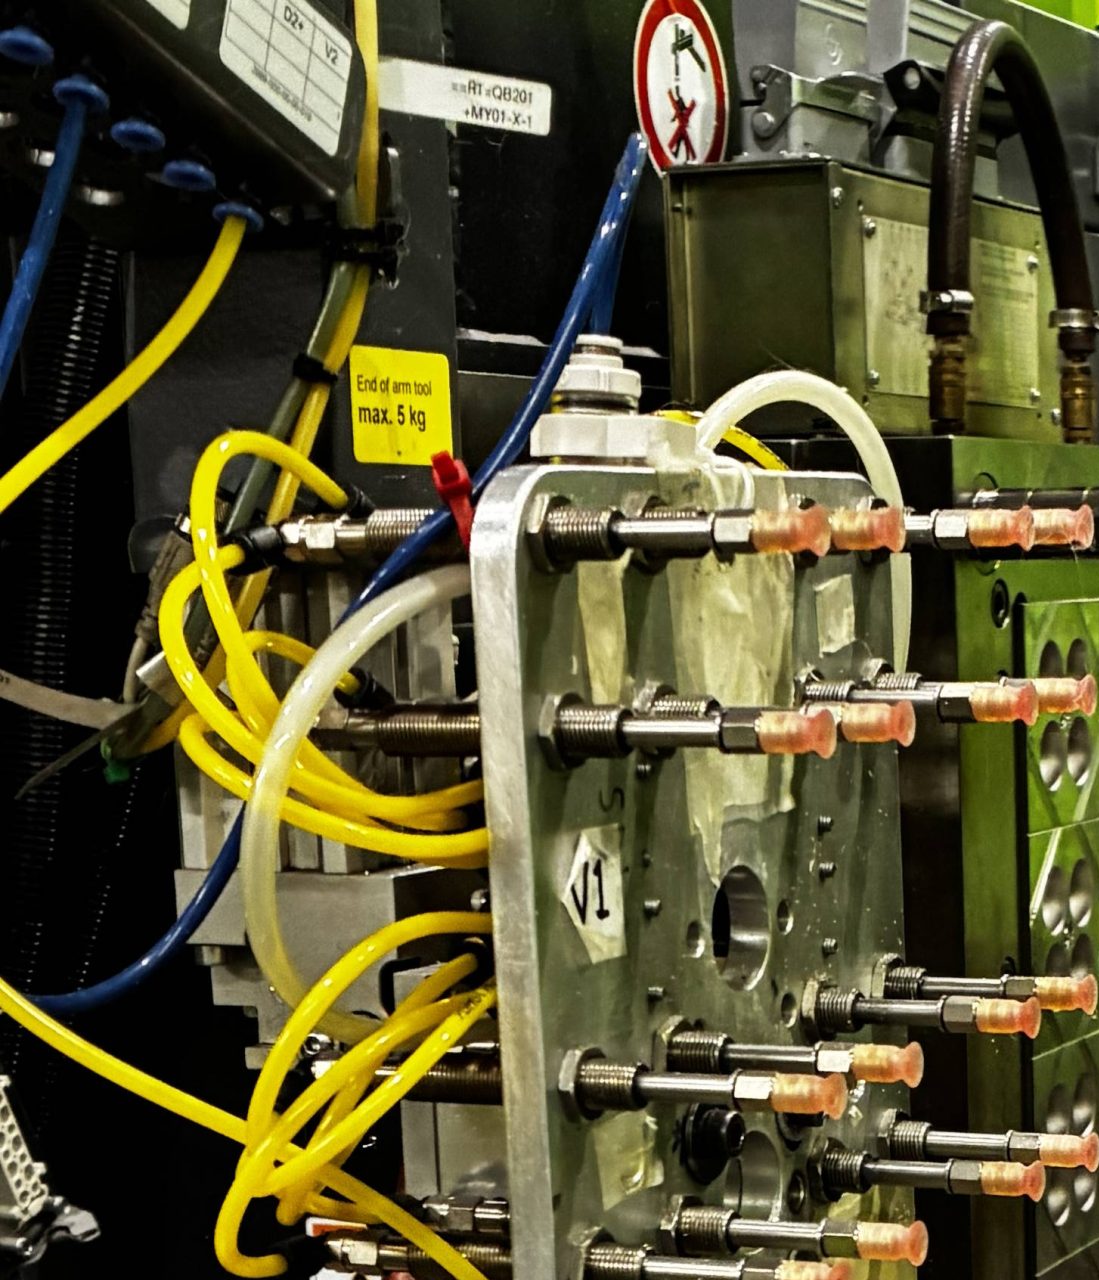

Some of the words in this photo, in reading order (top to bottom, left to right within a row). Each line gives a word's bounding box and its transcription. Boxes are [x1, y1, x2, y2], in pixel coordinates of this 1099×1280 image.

[356, 374, 377, 393] End
[380, 376, 390, 394] of
[392, 381, 412, 395] arm
[414, 380, 432, 396] tool
[358, 406, 393, 425] max.
[397, 404, 405, 426] 5
[409, 405, 426, 432] kg
[571, 858, 610, 925] V1
